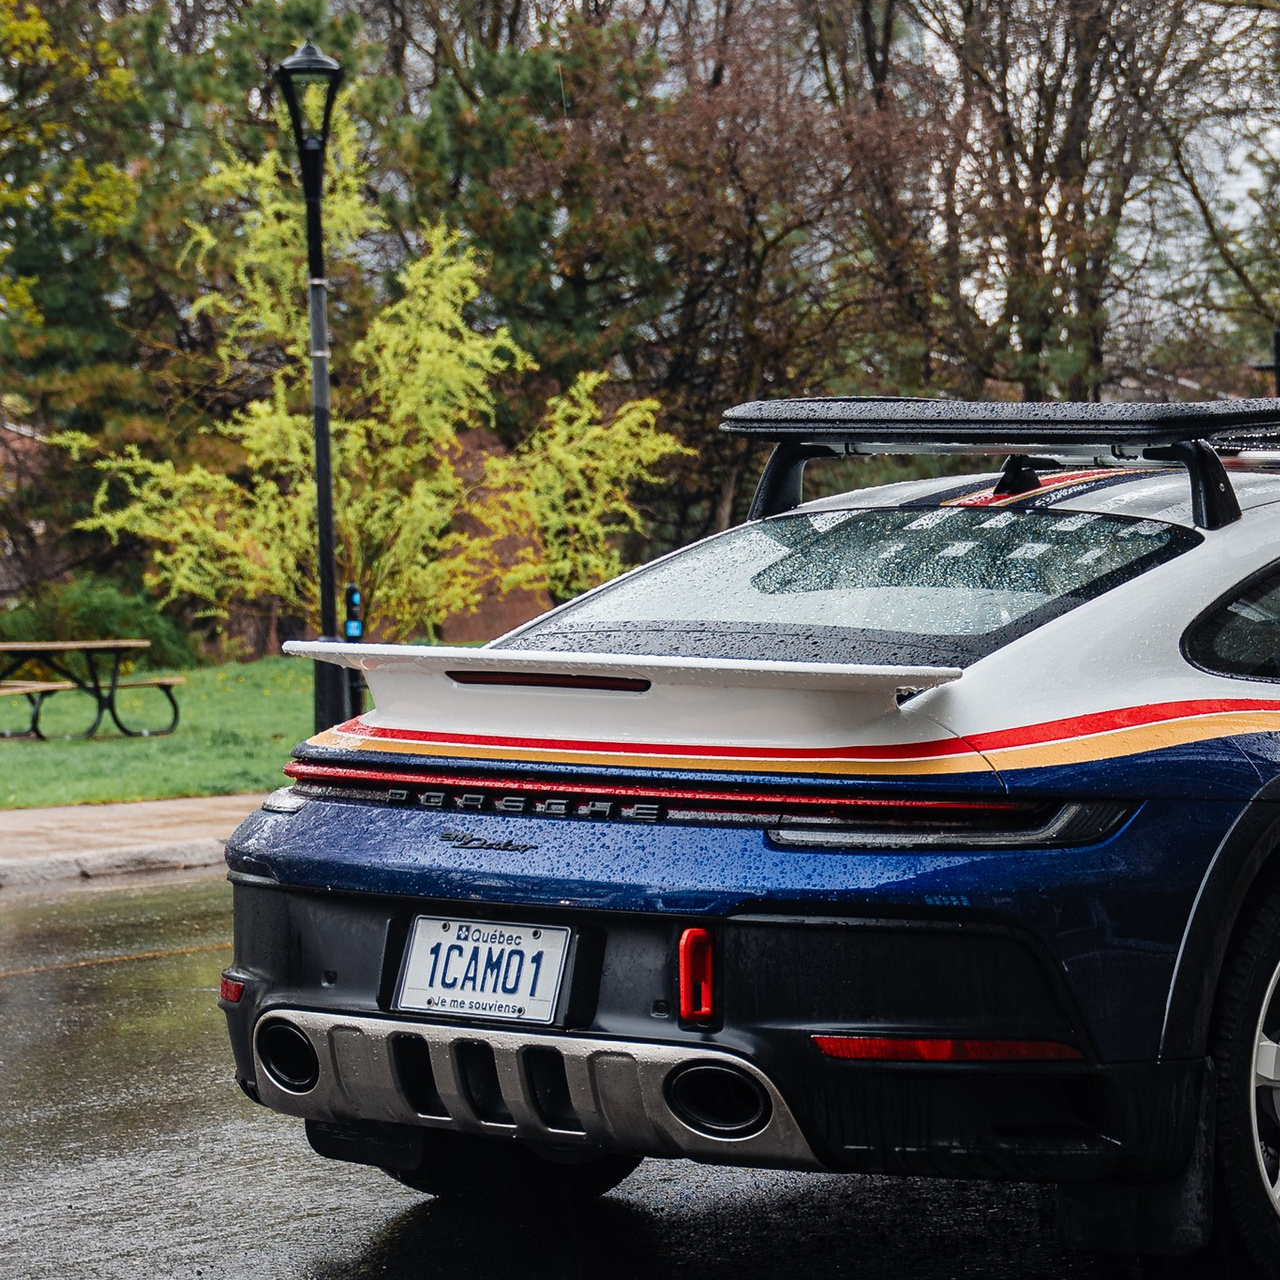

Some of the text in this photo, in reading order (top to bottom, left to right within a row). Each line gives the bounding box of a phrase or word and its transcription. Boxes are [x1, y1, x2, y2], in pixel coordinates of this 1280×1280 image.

[387, 788, 661, 820] PORSCHE
[451, 837, 539, 854] Dakar
[470, 928, 522, 946] Québec
[433, 995, 518, 1014] Je me souviens
